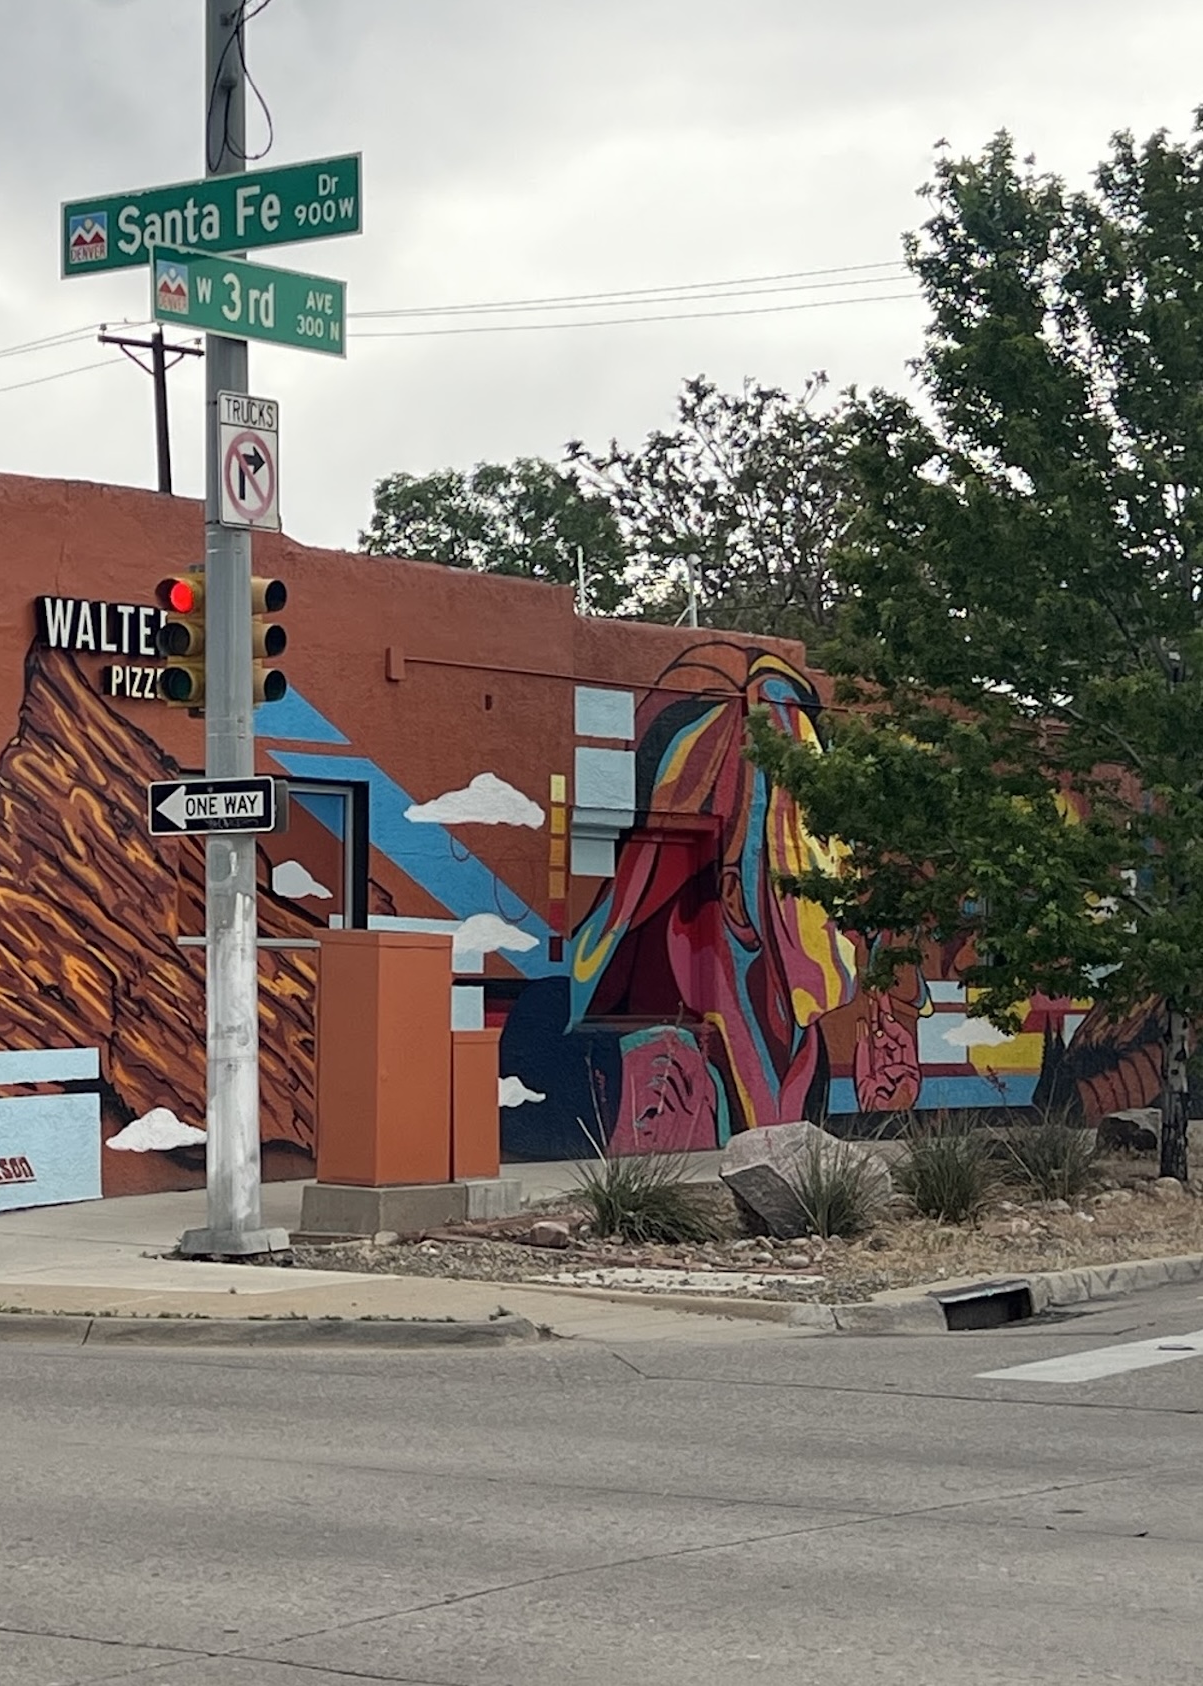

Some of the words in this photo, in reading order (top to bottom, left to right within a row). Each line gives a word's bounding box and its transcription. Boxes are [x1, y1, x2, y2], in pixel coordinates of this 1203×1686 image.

[318, 173, 339, 196] Dr
[117, 197, 220, 255] Santa
[236, 185, 281, 236] Fe
[71, 244, 105, 261] DENVER
[196, 275, 212, 304] W
[221, 272, 275, 328] 3rd
[306, 290, 333, 315] AVE
[296, 314, 324, 338] 300
[330, 321, 339, 341] N
[225, 398, 274, 428] TRUCKS
[44, 597, 168, 656] WALTE
[111, 665, 164, 699] PIZZ
[185, 797, 218, 817] ONE
[224, 794, 259, 815] WAY
